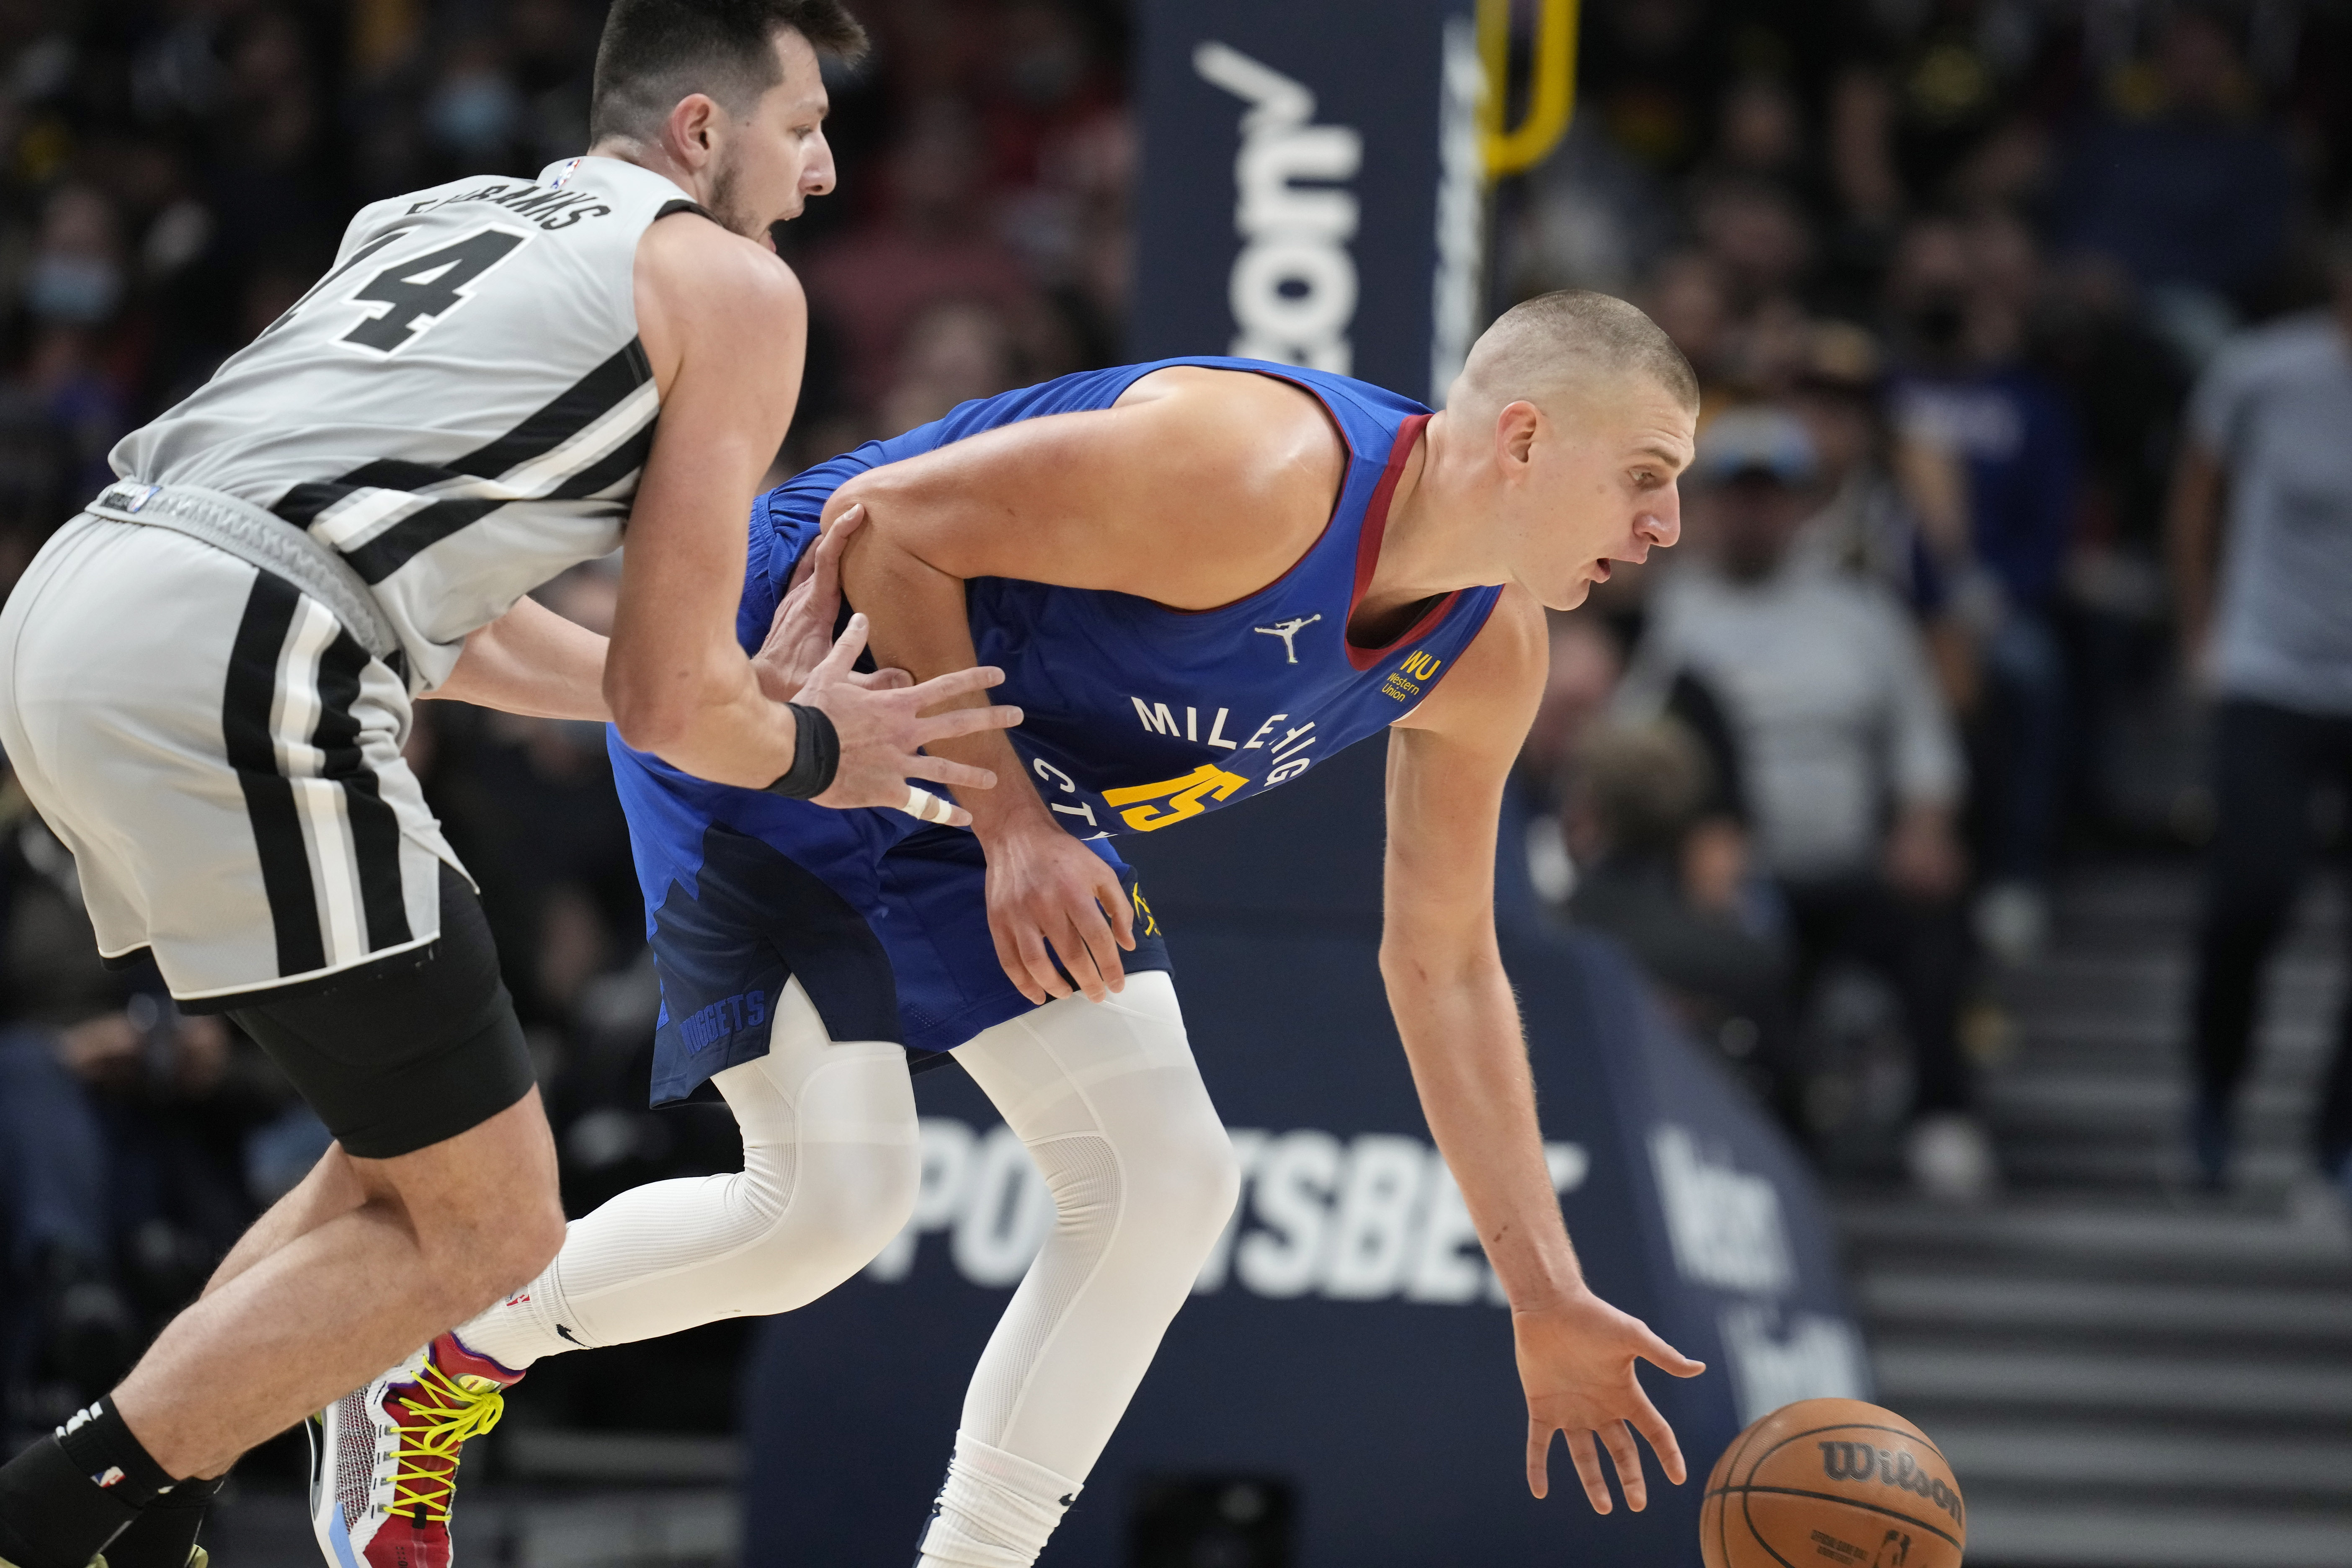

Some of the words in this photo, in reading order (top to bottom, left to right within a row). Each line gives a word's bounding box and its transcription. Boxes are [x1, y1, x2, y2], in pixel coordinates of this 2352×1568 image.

[1382, 683, 1406, 702] Union
[1387, 672, 1420, 696] Western
[1399, 650, 1442, 681] WU
[1131, 696, 1289, 750] MILE
[1251, 721, 1316, 797] HIG
[1101, 763, 1250, 832] 15
[679, 990, 765, 1056] NUGGETS
[1818, 1441, 1963, 1529] Wilson
